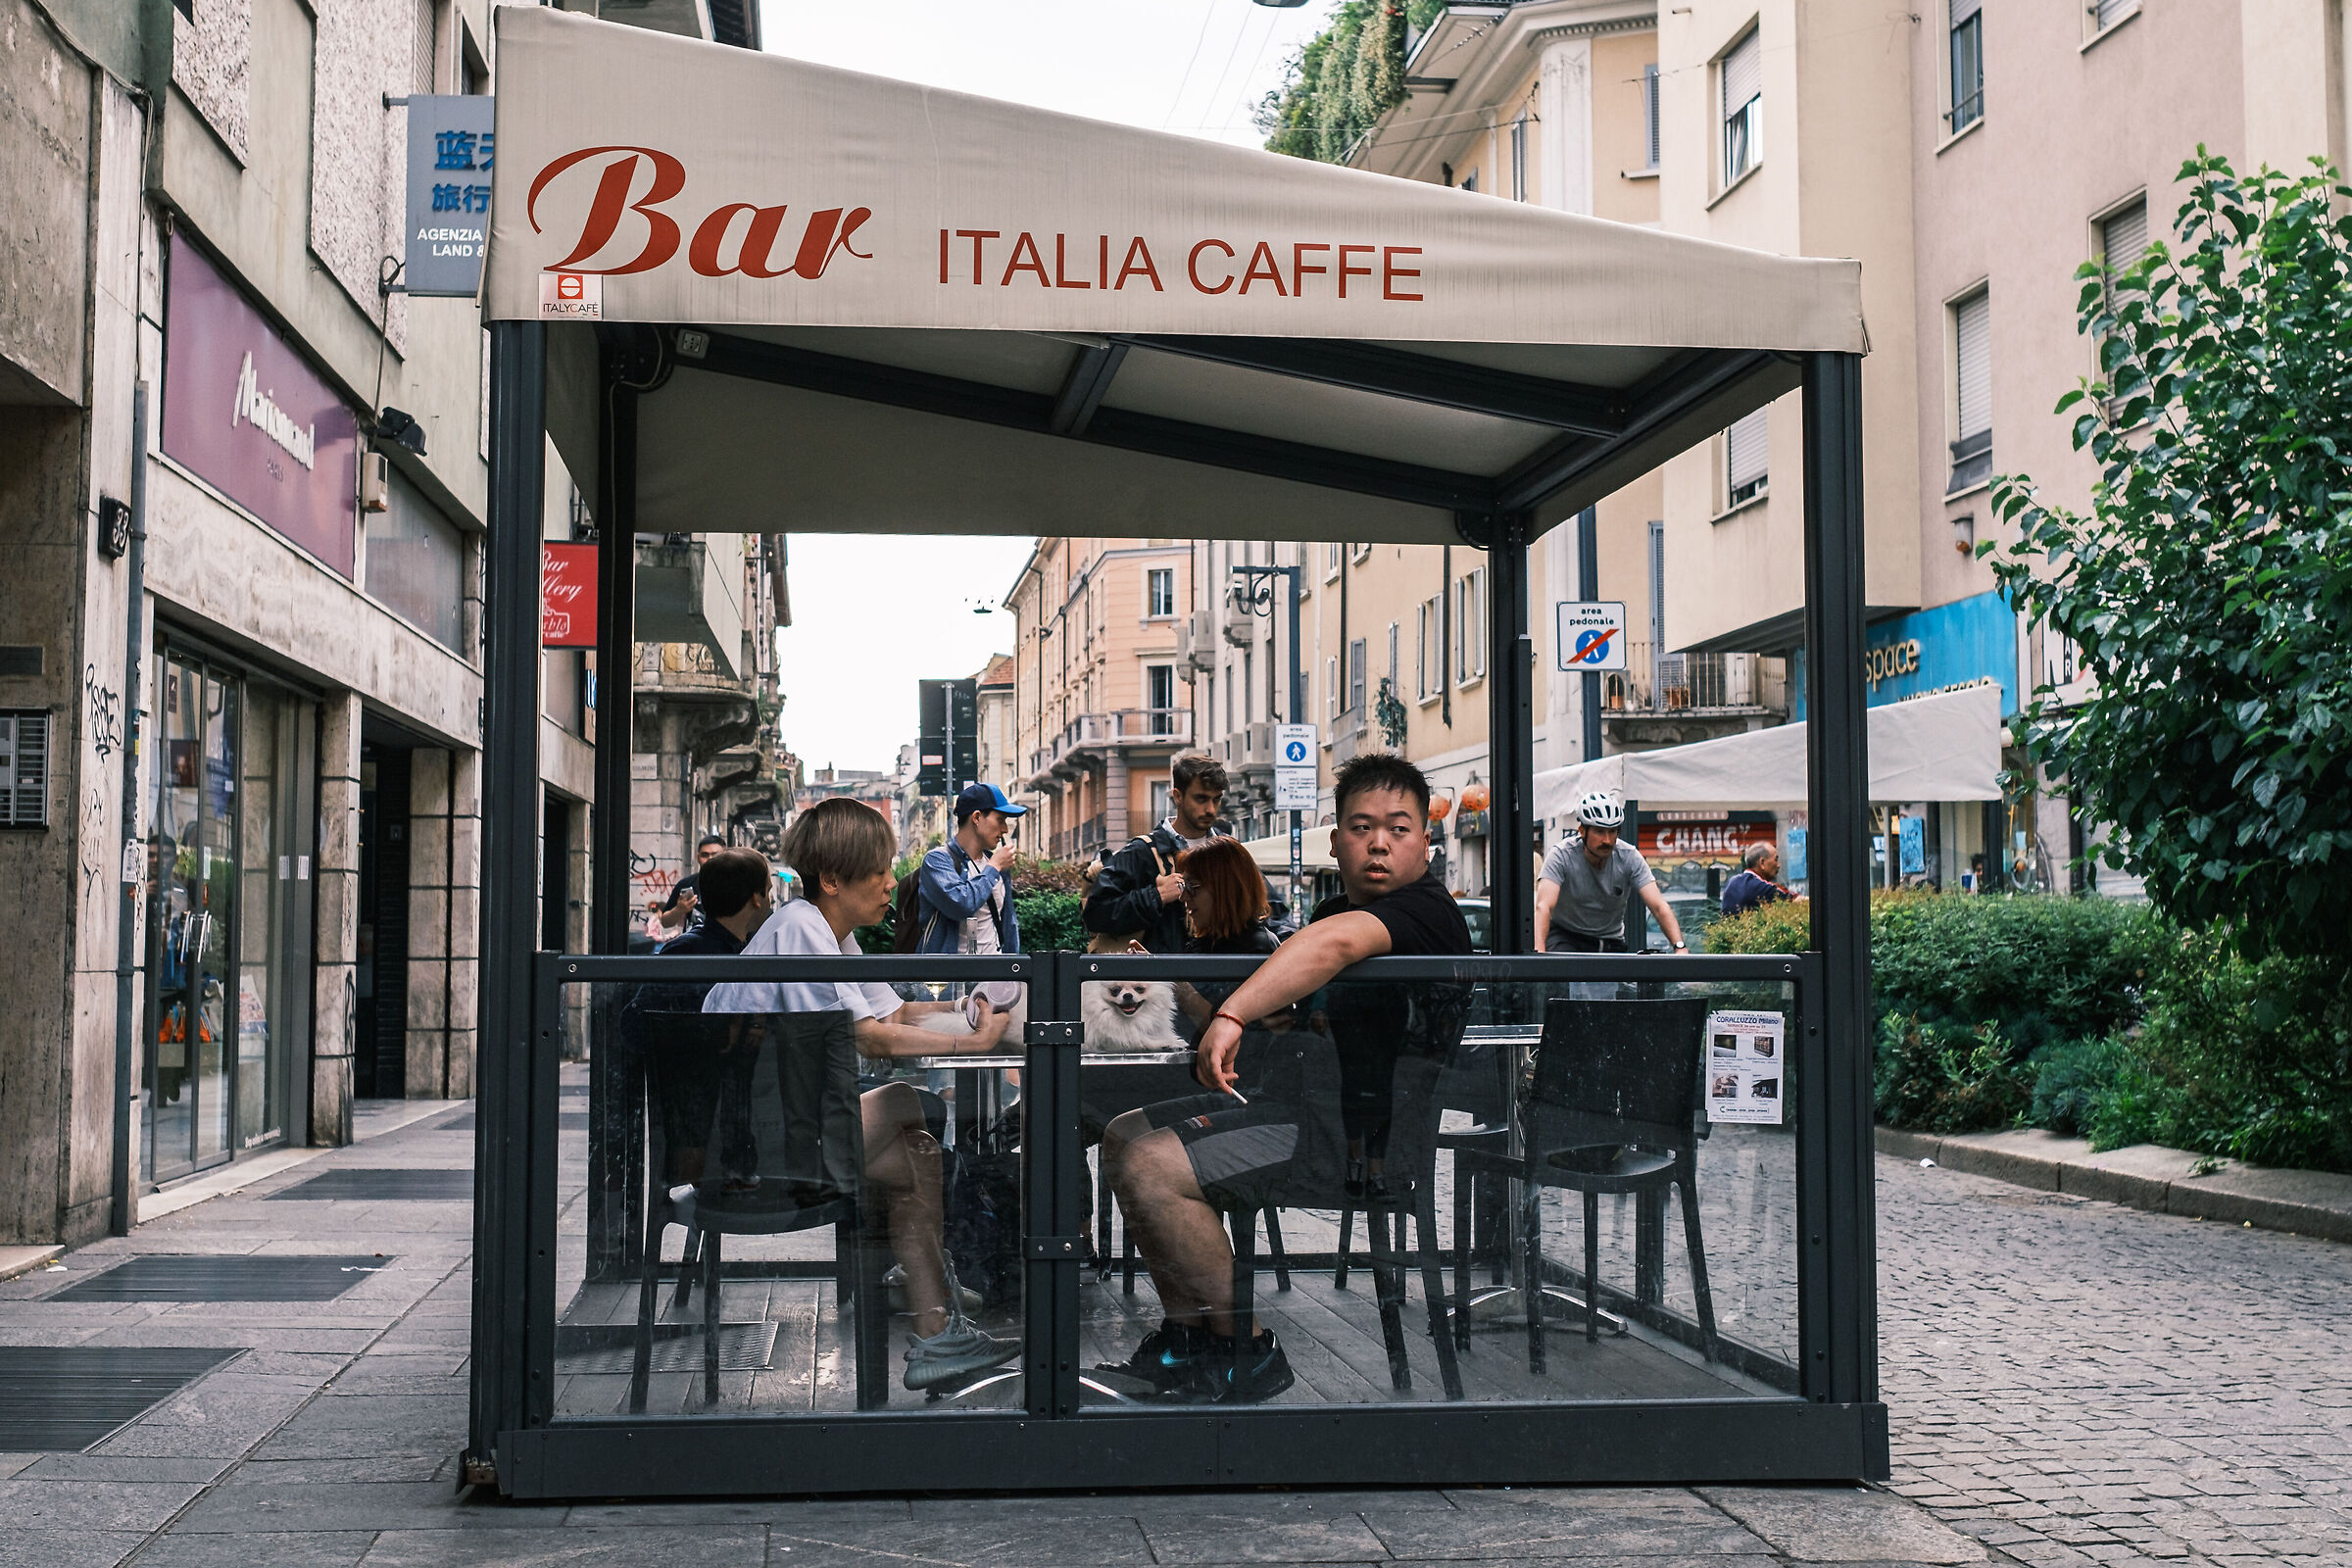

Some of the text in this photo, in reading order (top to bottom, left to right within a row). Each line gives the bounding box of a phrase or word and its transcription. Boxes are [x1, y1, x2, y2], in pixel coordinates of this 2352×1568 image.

[527, 145, 873, 280] Bar
[416, 227, 483, 242] AGENZIA
[432, 244, 473, 258] LAND
[939, 228, 1424, 302] ITALIA CAFFE
[113, 508, 129, 548] 33
[1569, 617, 1614, 626] pedonale
